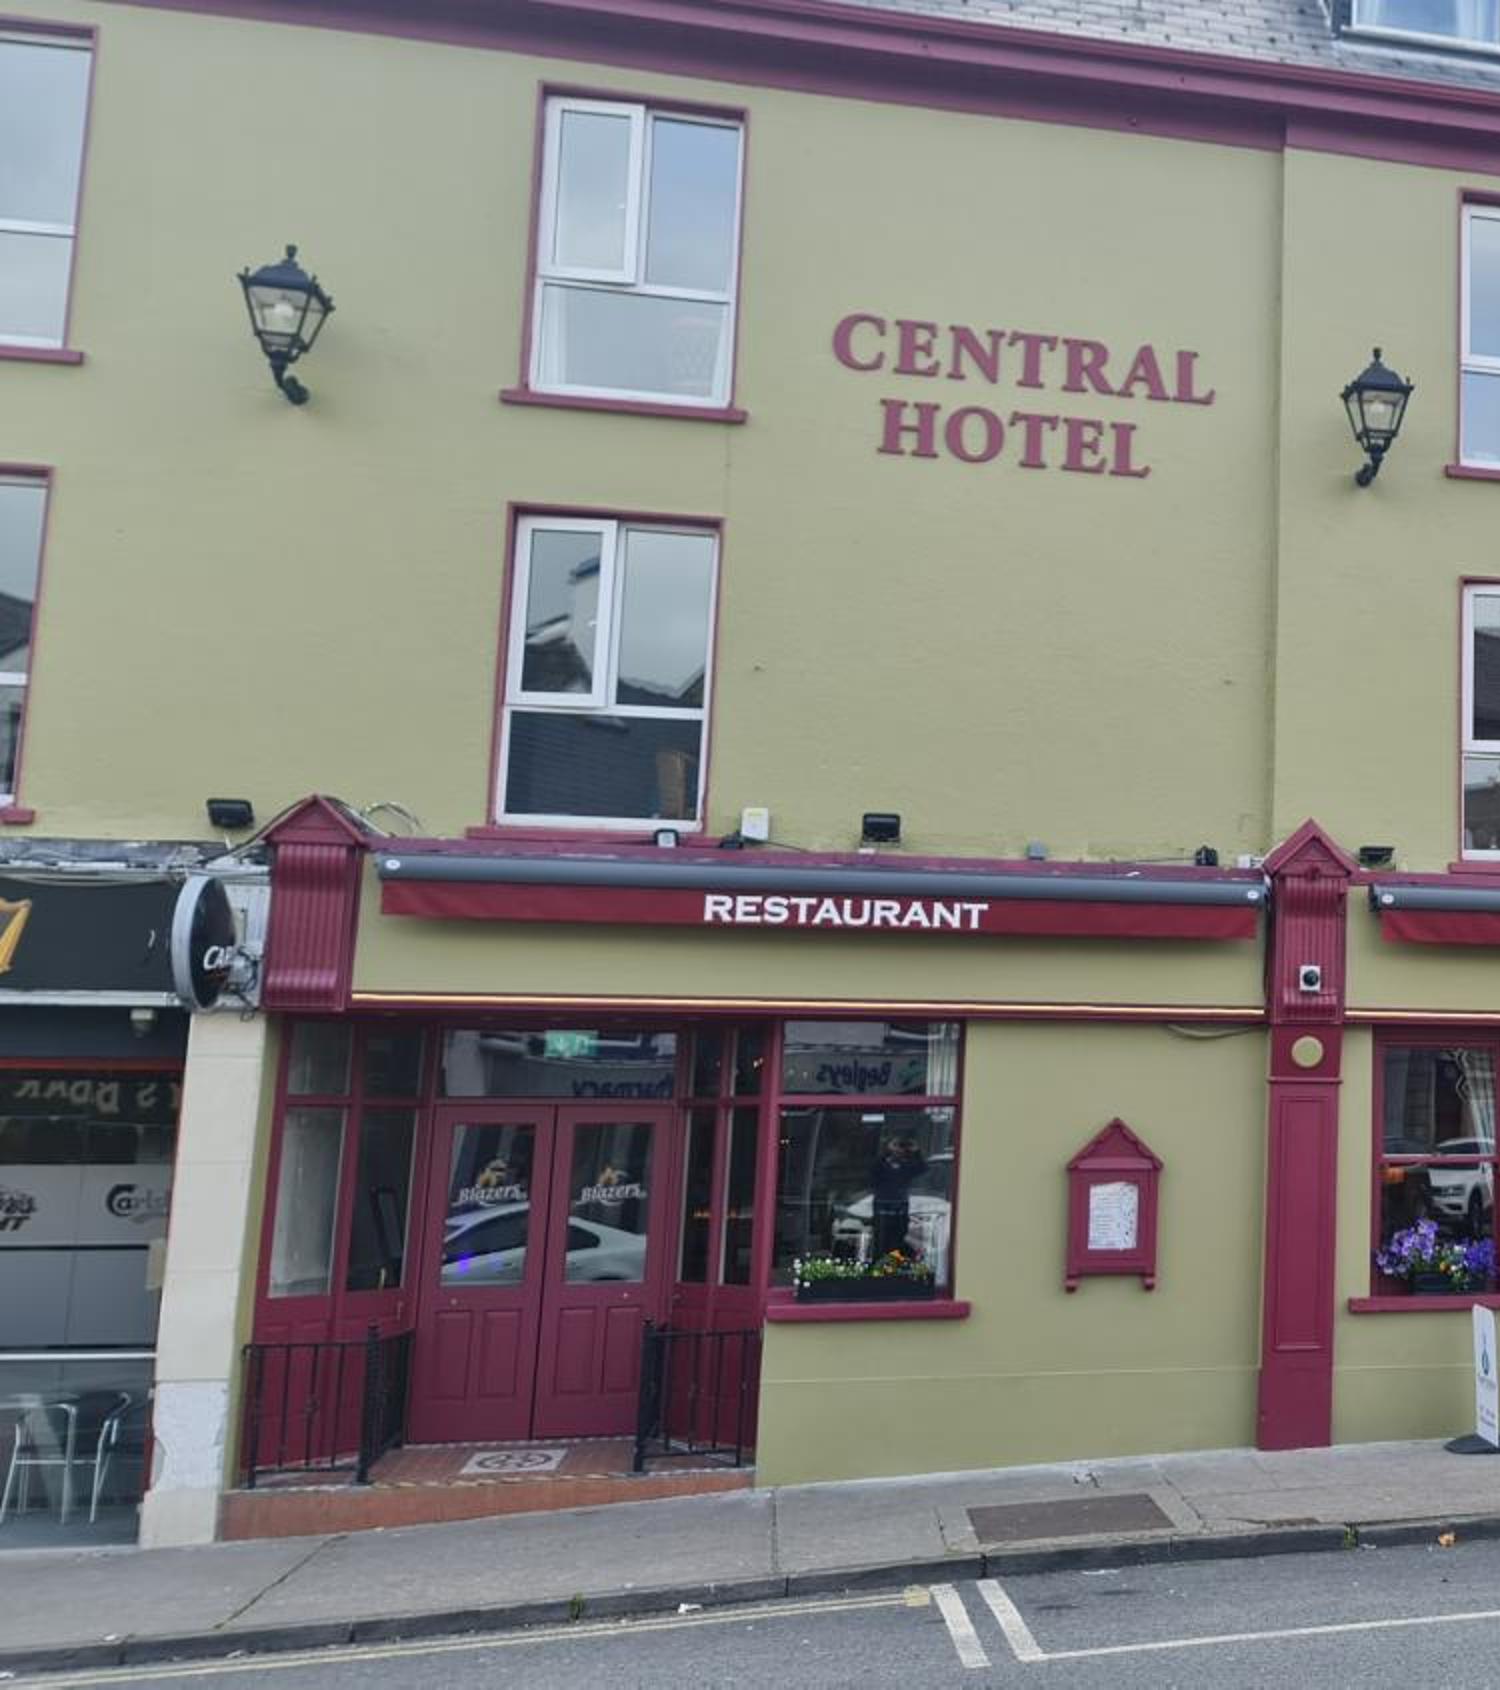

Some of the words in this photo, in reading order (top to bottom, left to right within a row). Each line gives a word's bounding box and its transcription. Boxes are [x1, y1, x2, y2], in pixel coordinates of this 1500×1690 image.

[832, 313, 1216, 405] CENTRAL
[877, 398, 1151, 478] HOTEL
[703, 894, 989, 929] RESTAURANT
[457, 1183, 522, 1202] Blazers
[580, 1182, 641, 1202] Blazers
